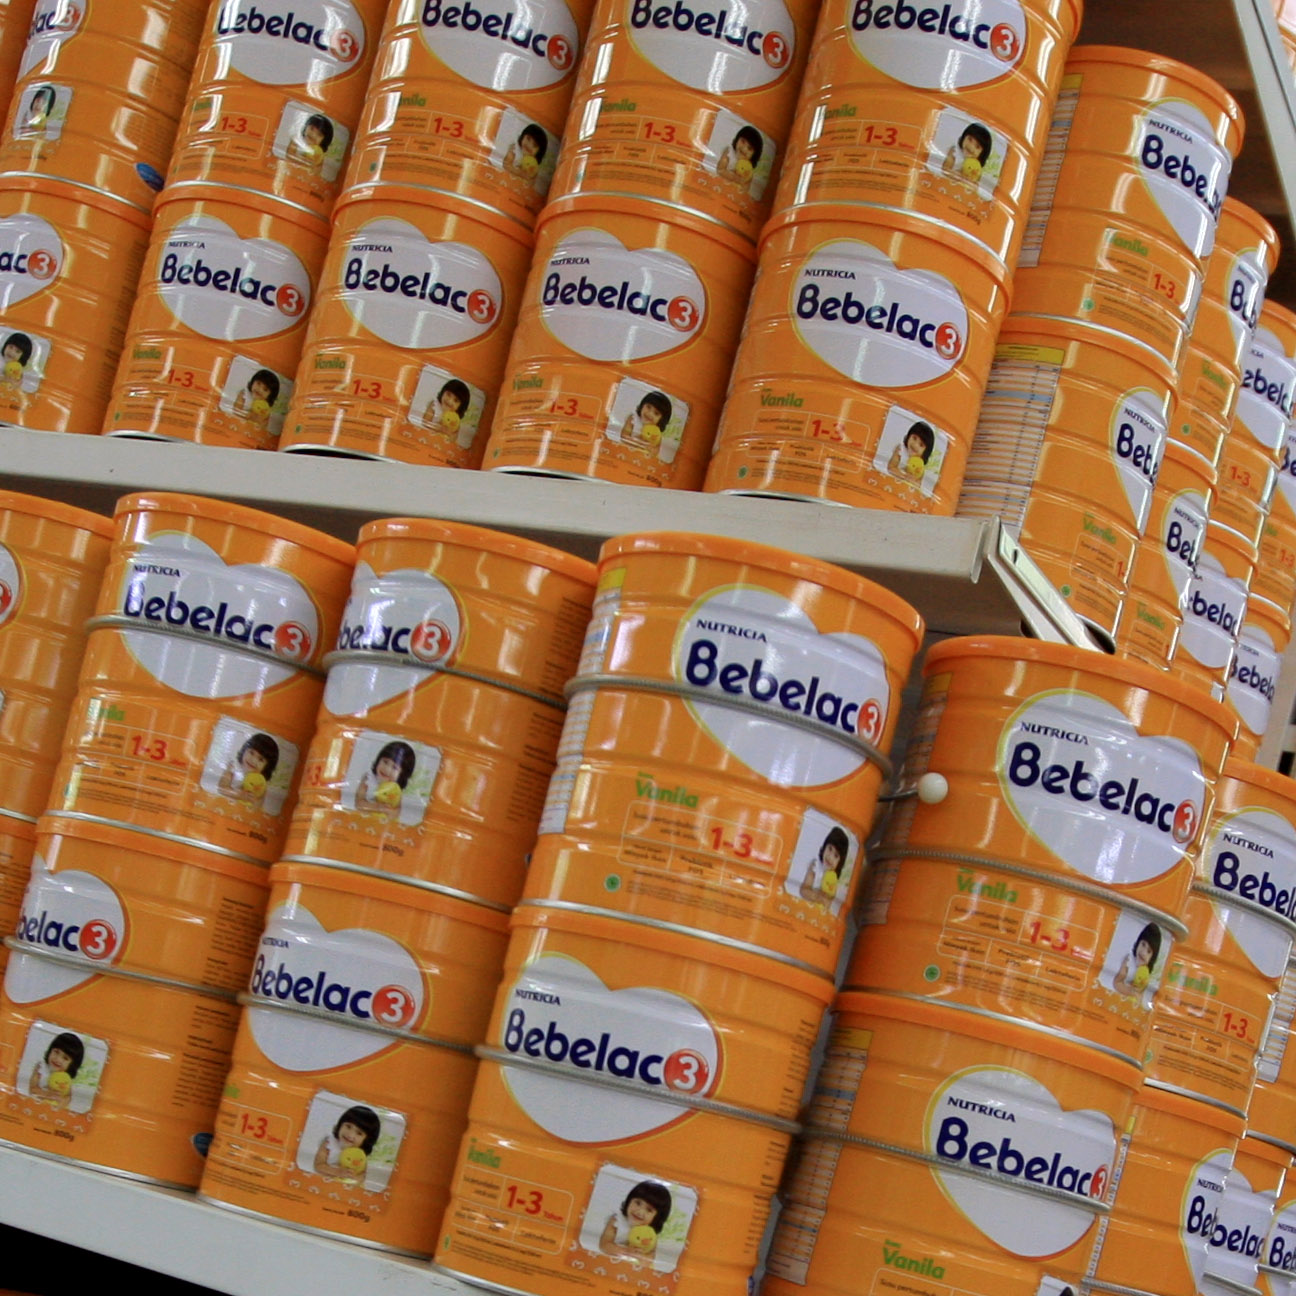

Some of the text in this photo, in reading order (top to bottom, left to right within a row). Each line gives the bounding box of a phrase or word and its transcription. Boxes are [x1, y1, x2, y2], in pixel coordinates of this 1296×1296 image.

[695, 617, 768, 643] NUTRICIA
[1020, 720, 1089, 745] NUTRICIA
[947, 1096, 1017, 1124] NUTRICIA
